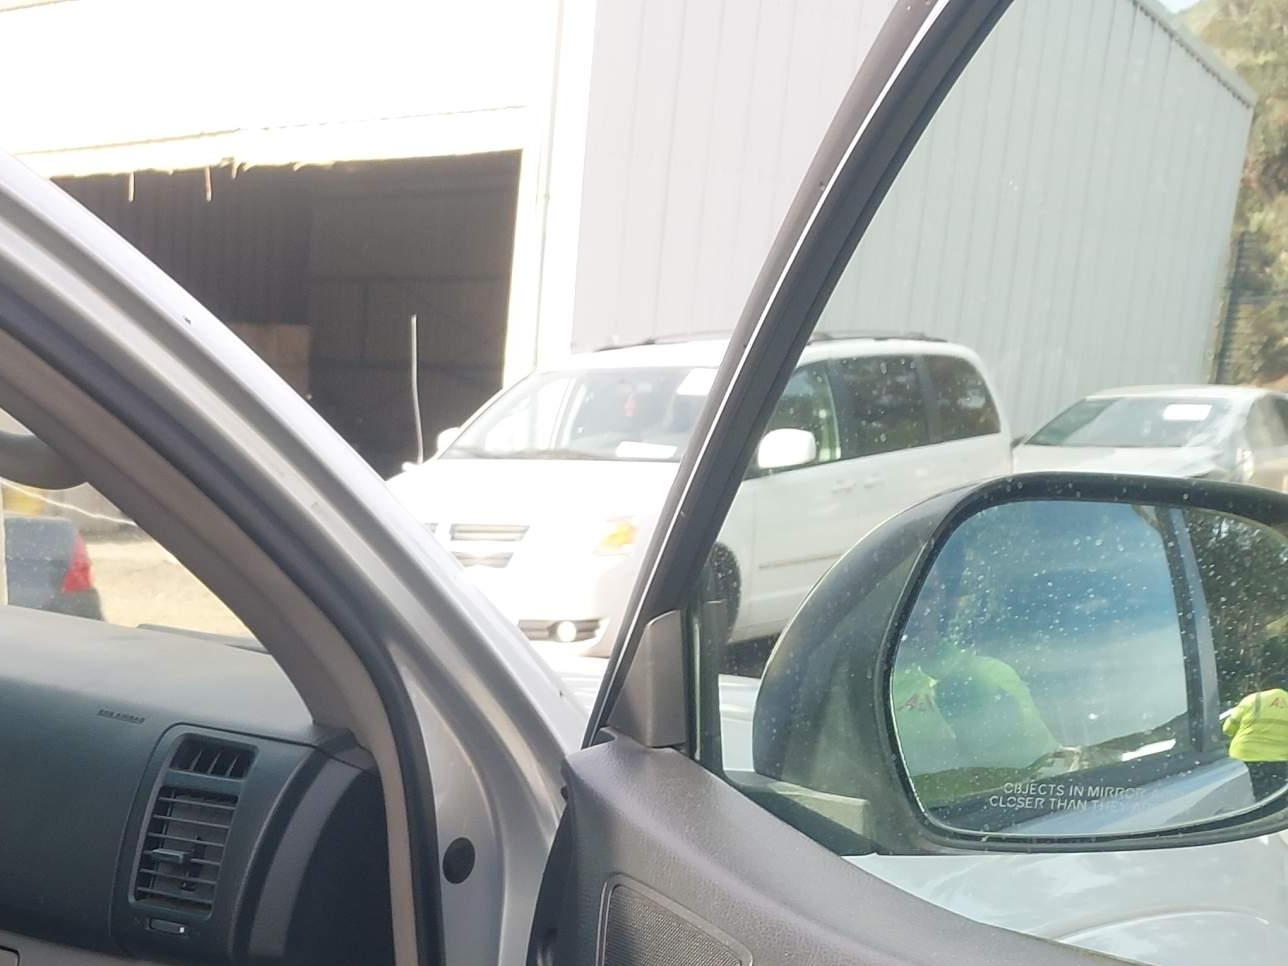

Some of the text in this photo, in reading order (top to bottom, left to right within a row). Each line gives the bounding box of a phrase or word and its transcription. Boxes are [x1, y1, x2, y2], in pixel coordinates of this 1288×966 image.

[1003, 782, 1065, 796] OBJECTS
[1069, 785, 1084, 797] IN
[1087, 786, 1146, 799] MIRROR
[989, 795, 1045, 809] CLOSER
[1049, 798, 1087, 810] THAN
